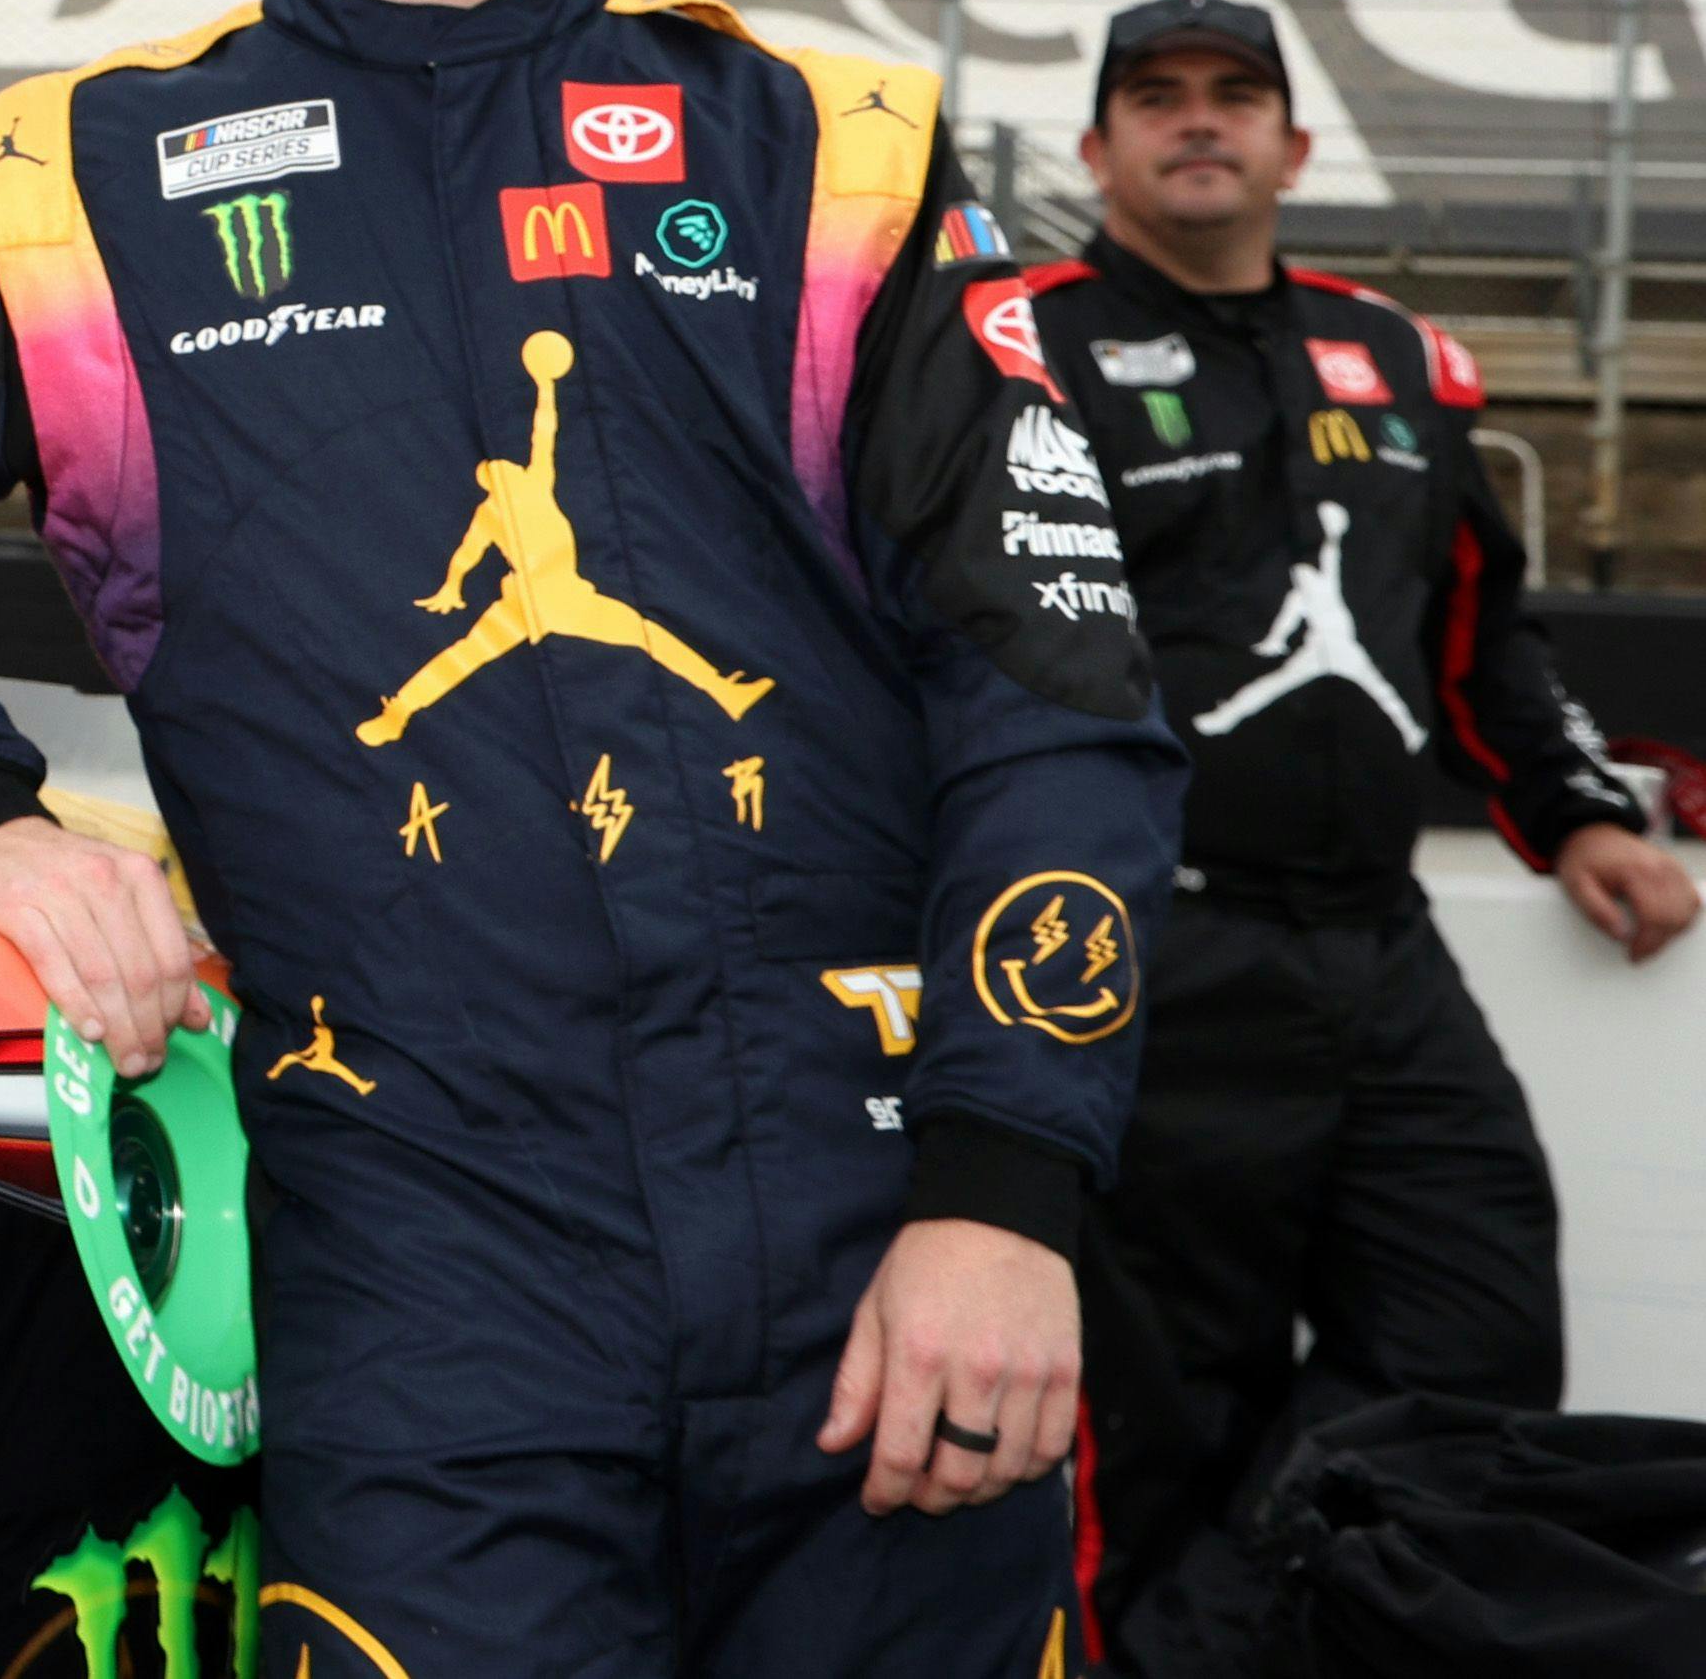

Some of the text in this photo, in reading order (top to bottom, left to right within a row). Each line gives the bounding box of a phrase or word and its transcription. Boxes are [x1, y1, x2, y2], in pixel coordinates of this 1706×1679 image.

[212, 108, 308, 145] NASCAR
[187, 137, 311, 178] CUP SERIES
[170, 303, 387, 354] GOODYEAR
[1002, 510, 1124, 562] Pinnac
[108, 1275, 168, 1385] GET
